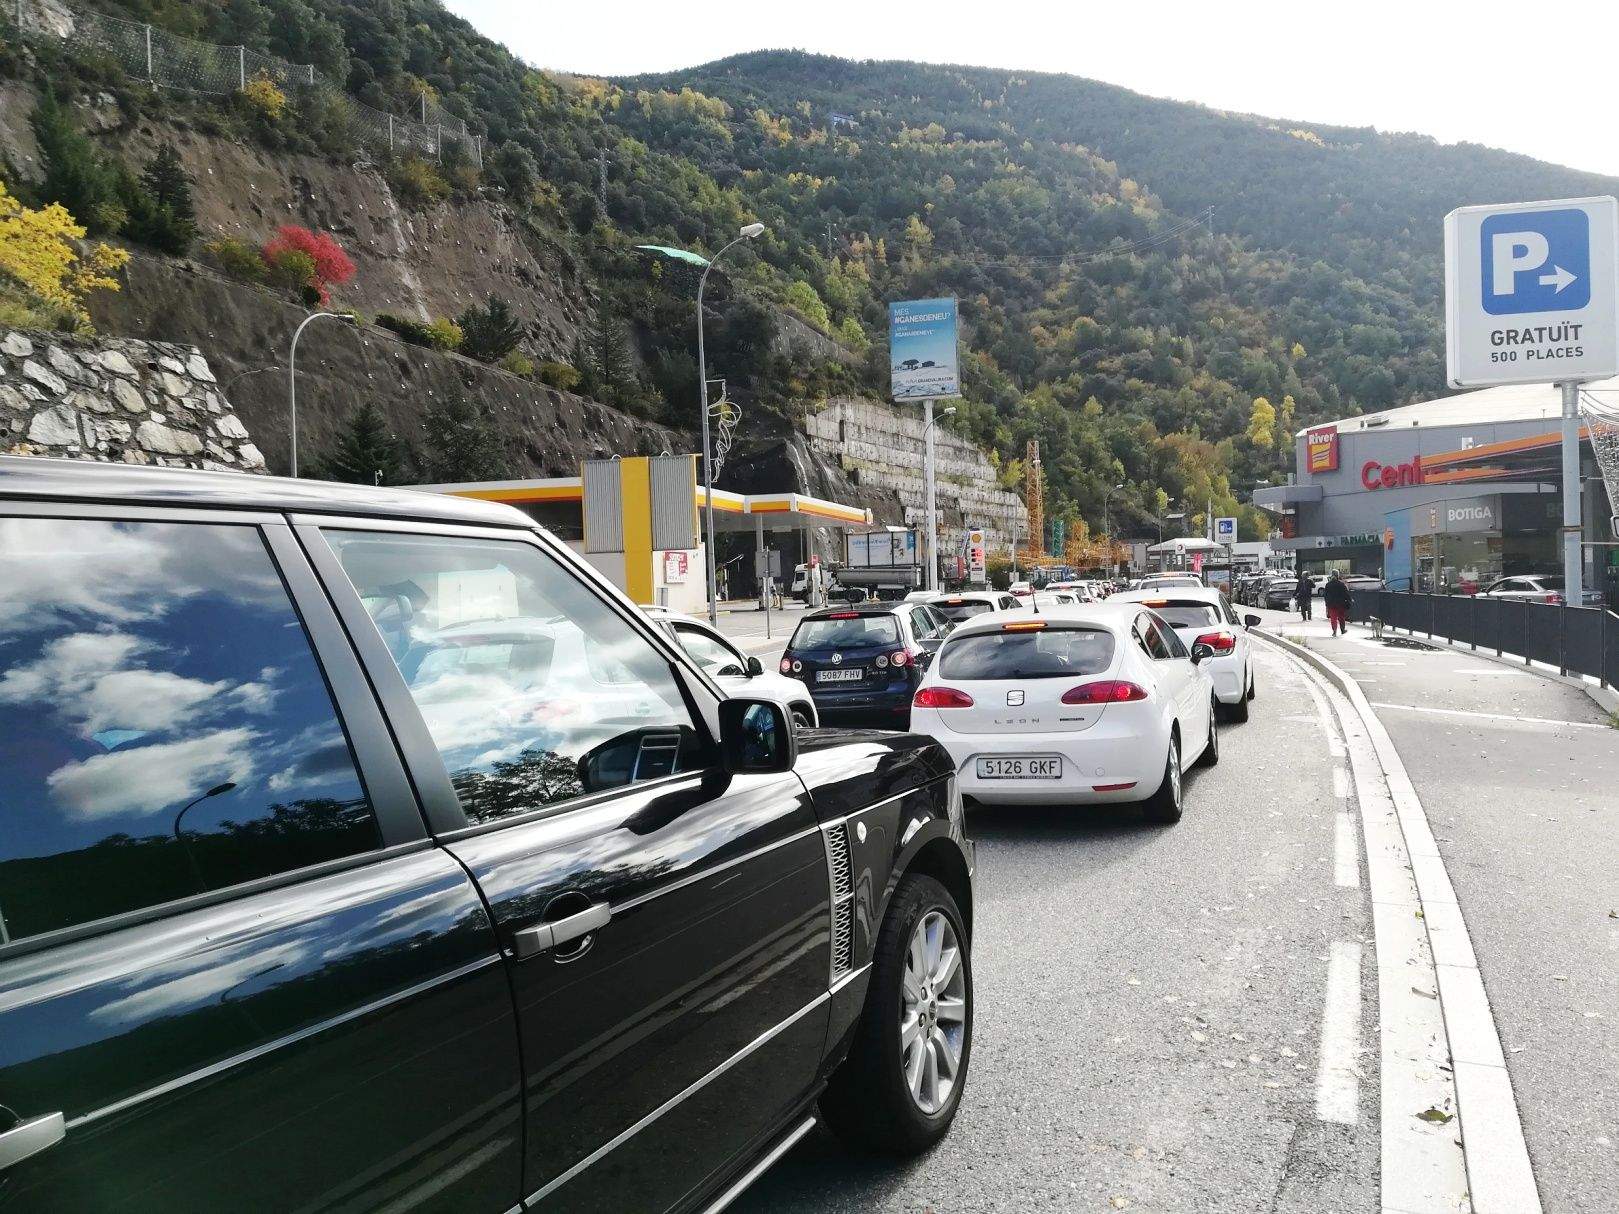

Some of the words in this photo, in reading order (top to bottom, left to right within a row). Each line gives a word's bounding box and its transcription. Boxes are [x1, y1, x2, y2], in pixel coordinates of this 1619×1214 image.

[1492, 231, 1549, 296] P
[1490, 321, 1583, 346] GRATUÏT
[1491, 351, 1517, 363] 500
[1526, 346, 1584, 361] PLACES
[1308, 432, 1335, 445] River
[1448, 506, 1492, 521] BOTIGA
[822, 670, 843, 680] 5087
[844, 670, 861, 679] FHV
[985, 760, 1022, 775] 5126
[1029, 760, 1058, 775] GKF
